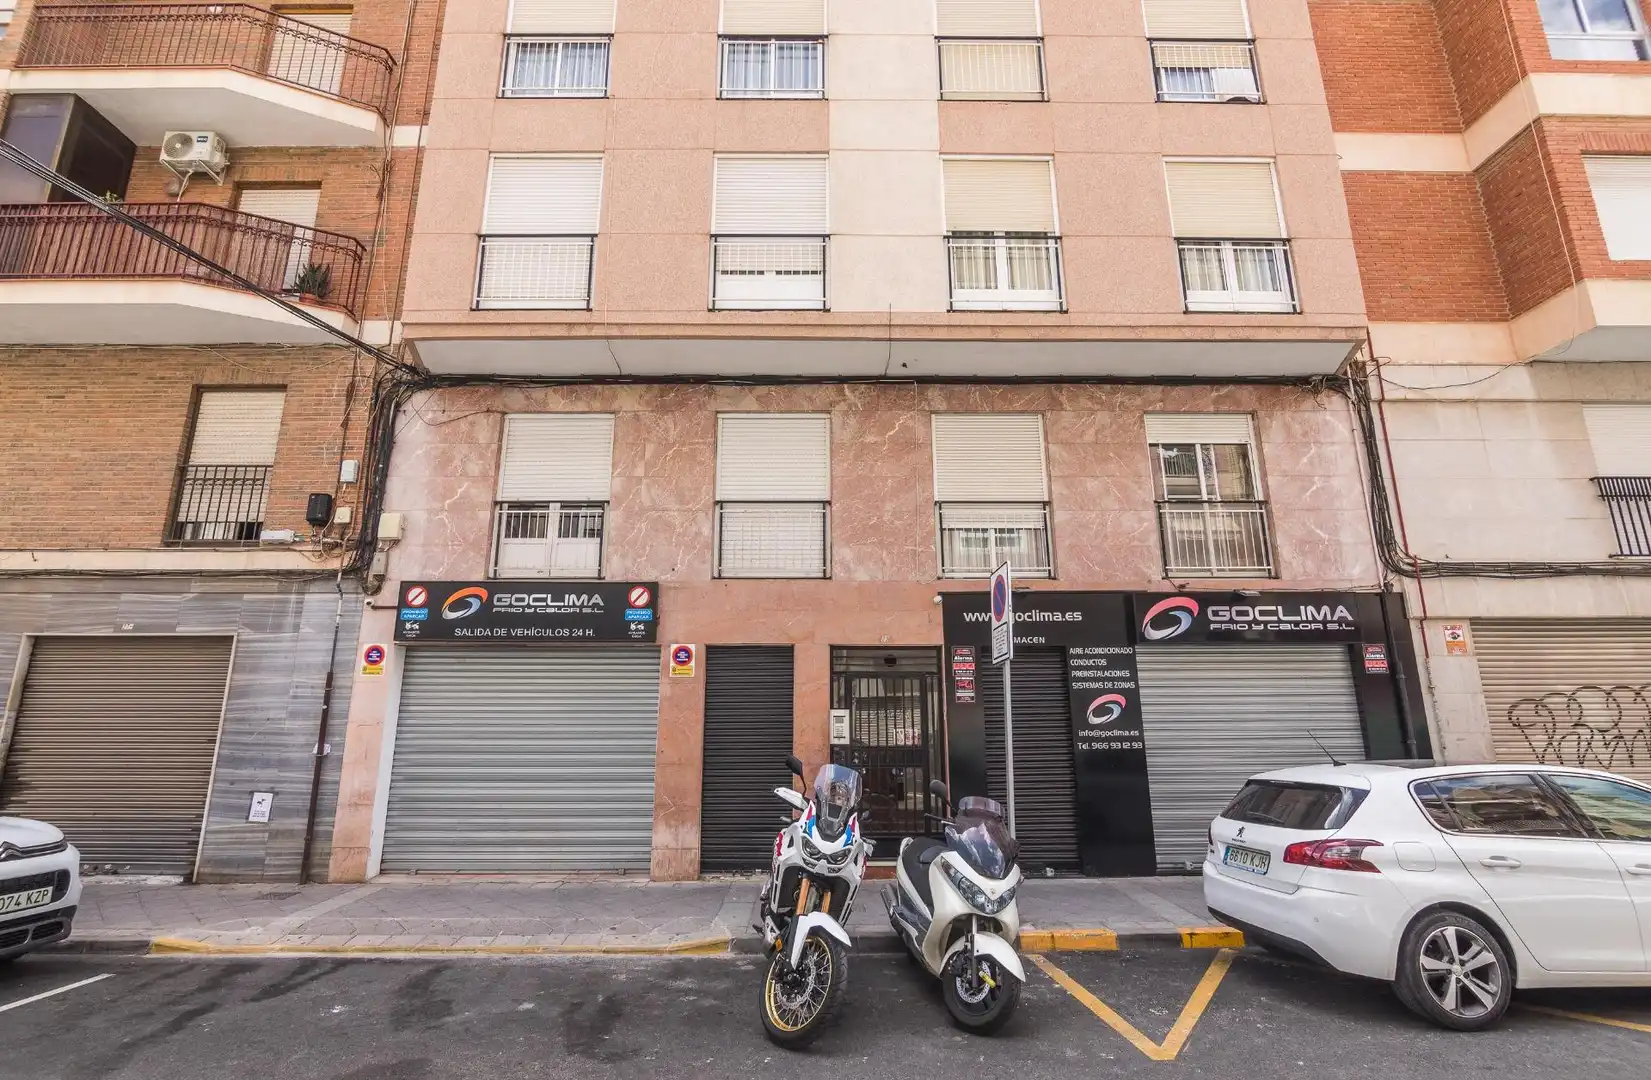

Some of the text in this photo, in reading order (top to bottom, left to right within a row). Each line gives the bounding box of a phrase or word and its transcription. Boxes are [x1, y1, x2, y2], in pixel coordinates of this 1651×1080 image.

[493, 593, 605, 606] GOCLIMA
[1207, 605, 1354, 621] GOCLIMA
[454, 626, 596, 637] SALIDA DE VEHÍCULOS 24 H.
[1013, 636, 1046, 644] MACEN
[1069, 647, 1084, 655] AIRE
[1070, 658, 1107, 666] CONDUCTOS
[1072, 681, 1136, 689] SISTEMAS DE ZONAS
[1078, 729, 1140, 738] info@goclima.es
[1091, 742, 1109, 750] 966
[1132, 741, 1143, 749] 93
[1229, 849, 1249, 864] 6610
[26, 889, 49, 906] KZP
